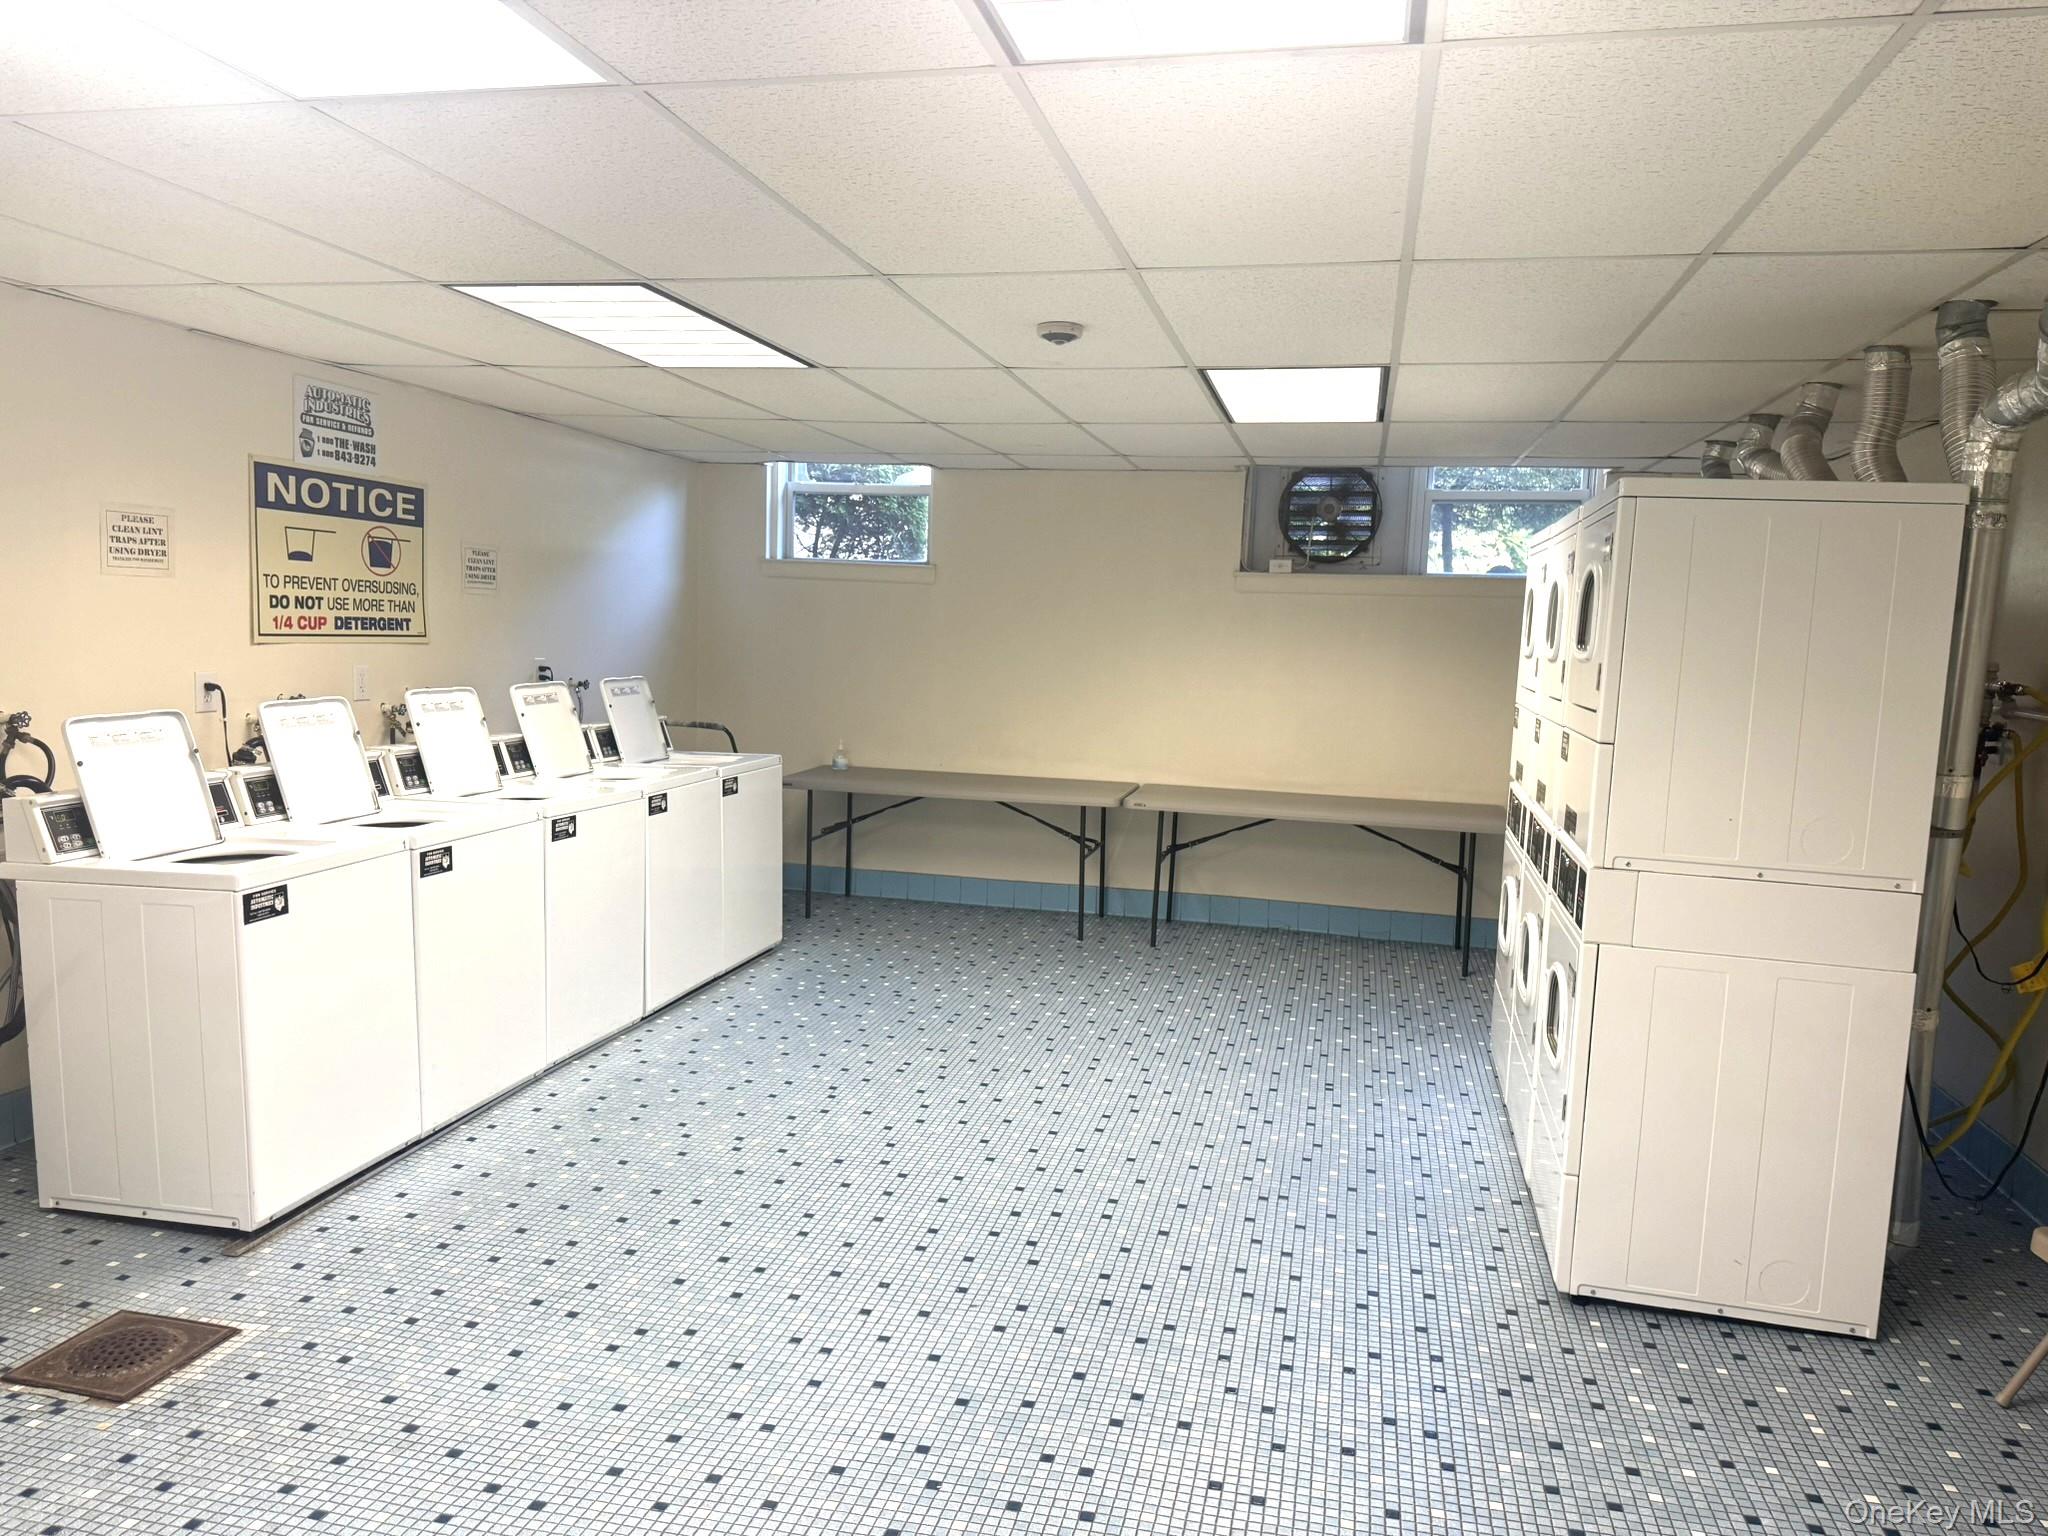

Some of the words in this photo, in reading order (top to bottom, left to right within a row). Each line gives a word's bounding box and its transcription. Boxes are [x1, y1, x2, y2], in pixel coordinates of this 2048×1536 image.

[304, 384, 371, 413] AUTOMATIC
[303, 399, 372, 426] INDUSTRIES
[267, 471, 416, 521] NOTICE
[121, 514, 154, 524] PLEASE
[112, 524, 140, 534] CLEAN
[142, 526, 163, 535] LINT
[109, 535, 137, 544] TRAPS
[138, 537, 166, 546] AFTER
[109, 546, 136, 555] USING
[137, 548, 167, 557] DRYER
[263, 574, 279, 589] TO
[283, 575, 339, 591] PREVENT
[341, 578, 419, 598] OVERSUDSING,
[269, 594, 290, 609] DO
[294, 596, 324, 610] NOT
[327, 598, 349, 611] USE
[352, 598, 385, 612] MORE
[387, 599, 416, 613] THAN
[272, 616, 293, 630] 1/4
[297, 616, 327, 630] CUP
[334, 616, 412, 631] DETERGENT
